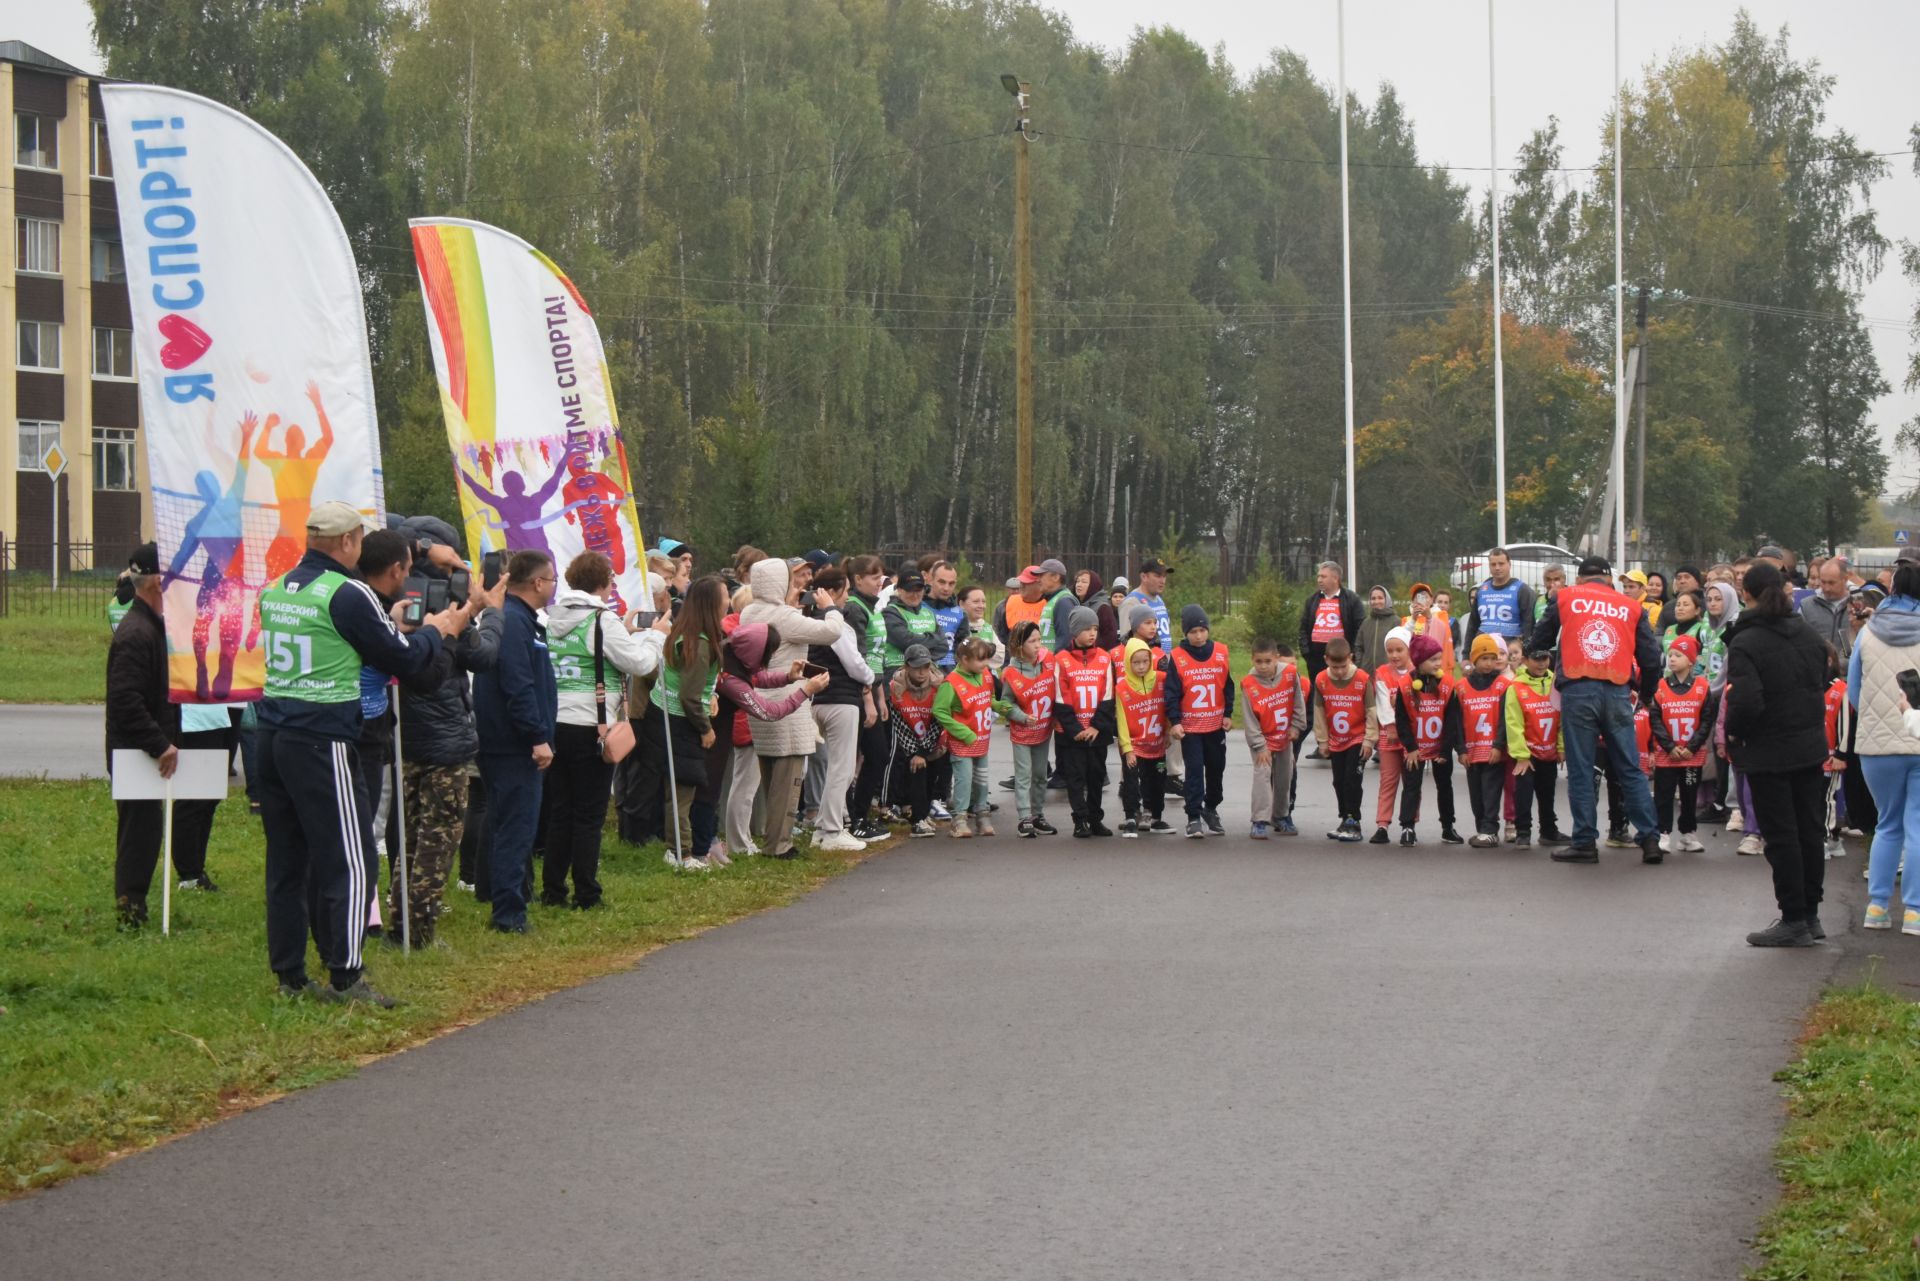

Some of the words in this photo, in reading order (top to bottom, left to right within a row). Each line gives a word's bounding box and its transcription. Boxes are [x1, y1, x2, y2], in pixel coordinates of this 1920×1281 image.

[131, 116, 205, 310] СПОРТ!
[544, 295, 577, 389] СПОРТА!
[164, 373, 216, 404] Я
[561, 394, 594, 470] РИТМЕ
[576, 474, 597, 490] В
[270, 613, 300, 626] РАЙОН
[1315, 613, 1339, 628] 49
[1478, 604, 1512, 622] 216
[1571, 598, 1629, 622] СУДЬЯ
[1184, 667, 1223, 676] ТУКАЕВСКИЙ
[1030, 695, 1052, 720] 12
[1075, 686, 1098, 709] 11
[1190, 684, 1216, 708] 21
[1267, 697, 1289, 708] РАЙОН
[975, 707, 992, 732] 18
[1273, 707, 1288, 731] 5
[1333, 711, 1350, 734] 6
[1669, 707, 1695, 715] РАЙОН
[1137, 715, 1162, 738] 14
[1416, 716, 1443, 739] 10
[1475, 713, 1492, 737] 4
[1539, 718, 1554, 742] 7
[1668, 718, 1696, 742] 13
